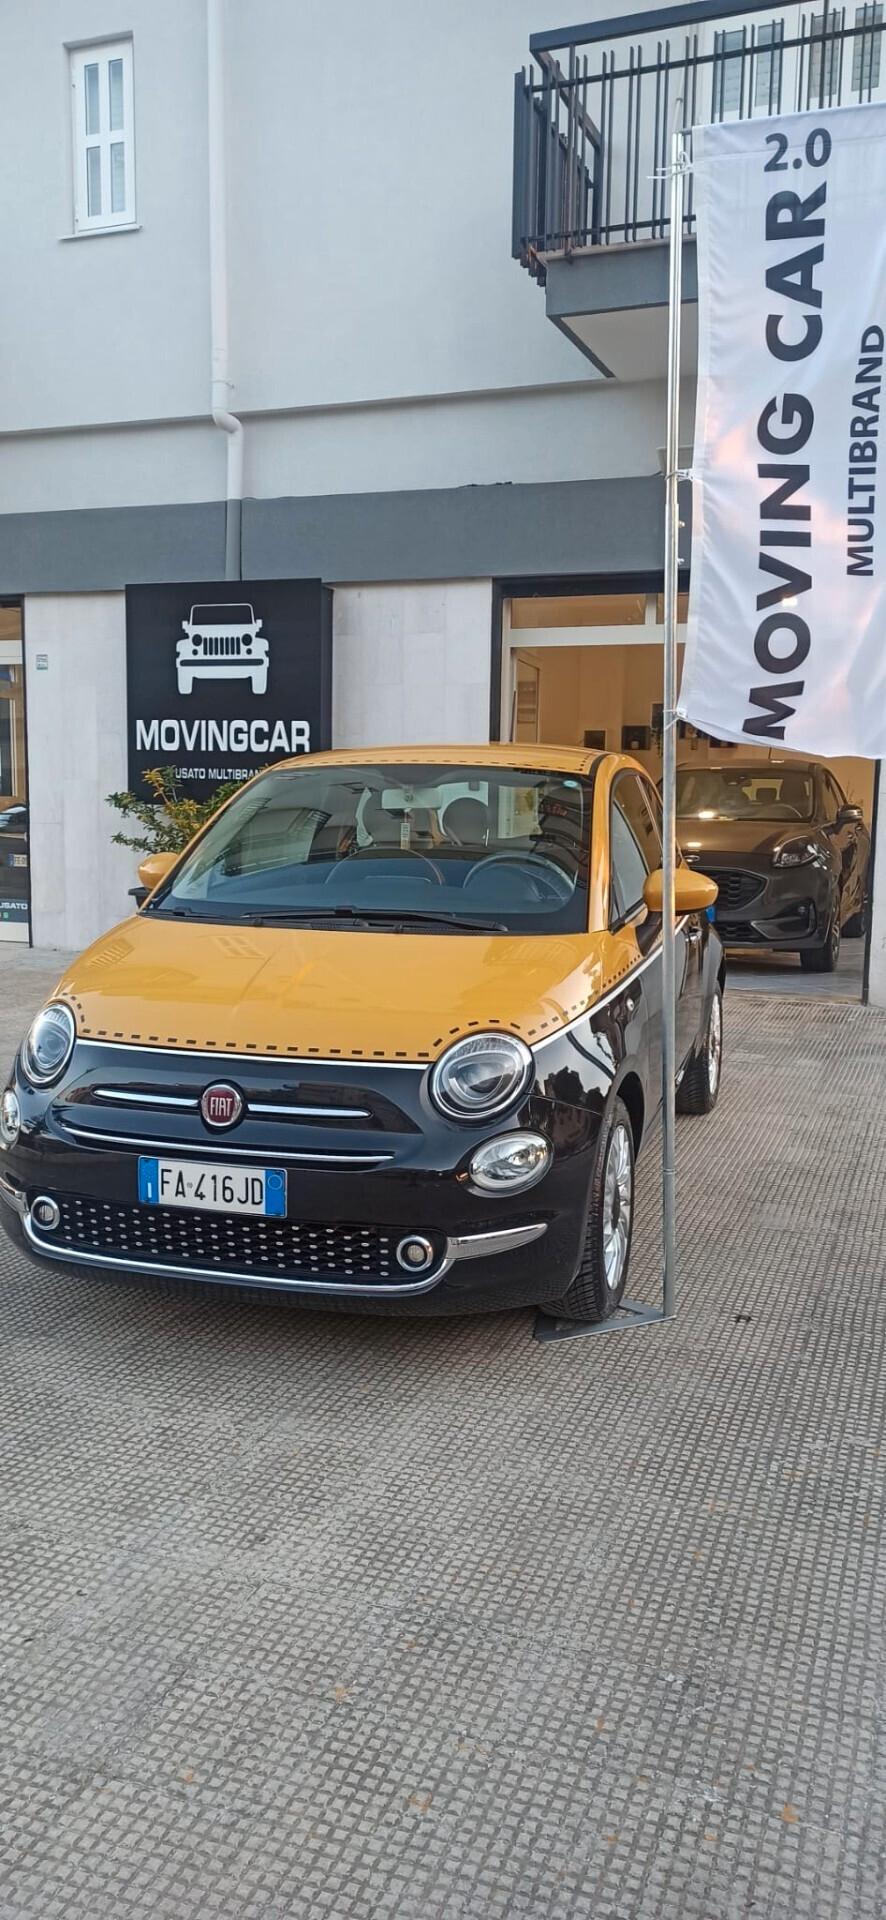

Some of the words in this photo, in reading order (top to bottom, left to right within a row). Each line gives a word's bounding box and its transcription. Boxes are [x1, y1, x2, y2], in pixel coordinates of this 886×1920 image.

[764, 128, 832, 172] 2.0
[765, 181, 828, 362] CAR
[847, 325, 885, 576] MULTIBRAND
[742, 393, 815, 740] MOVING
[136, 719, 311, 753] MOVINGCAR
[175, 768, 206, 779] USATO
[210, 1097, 233, 1117] FIAT
